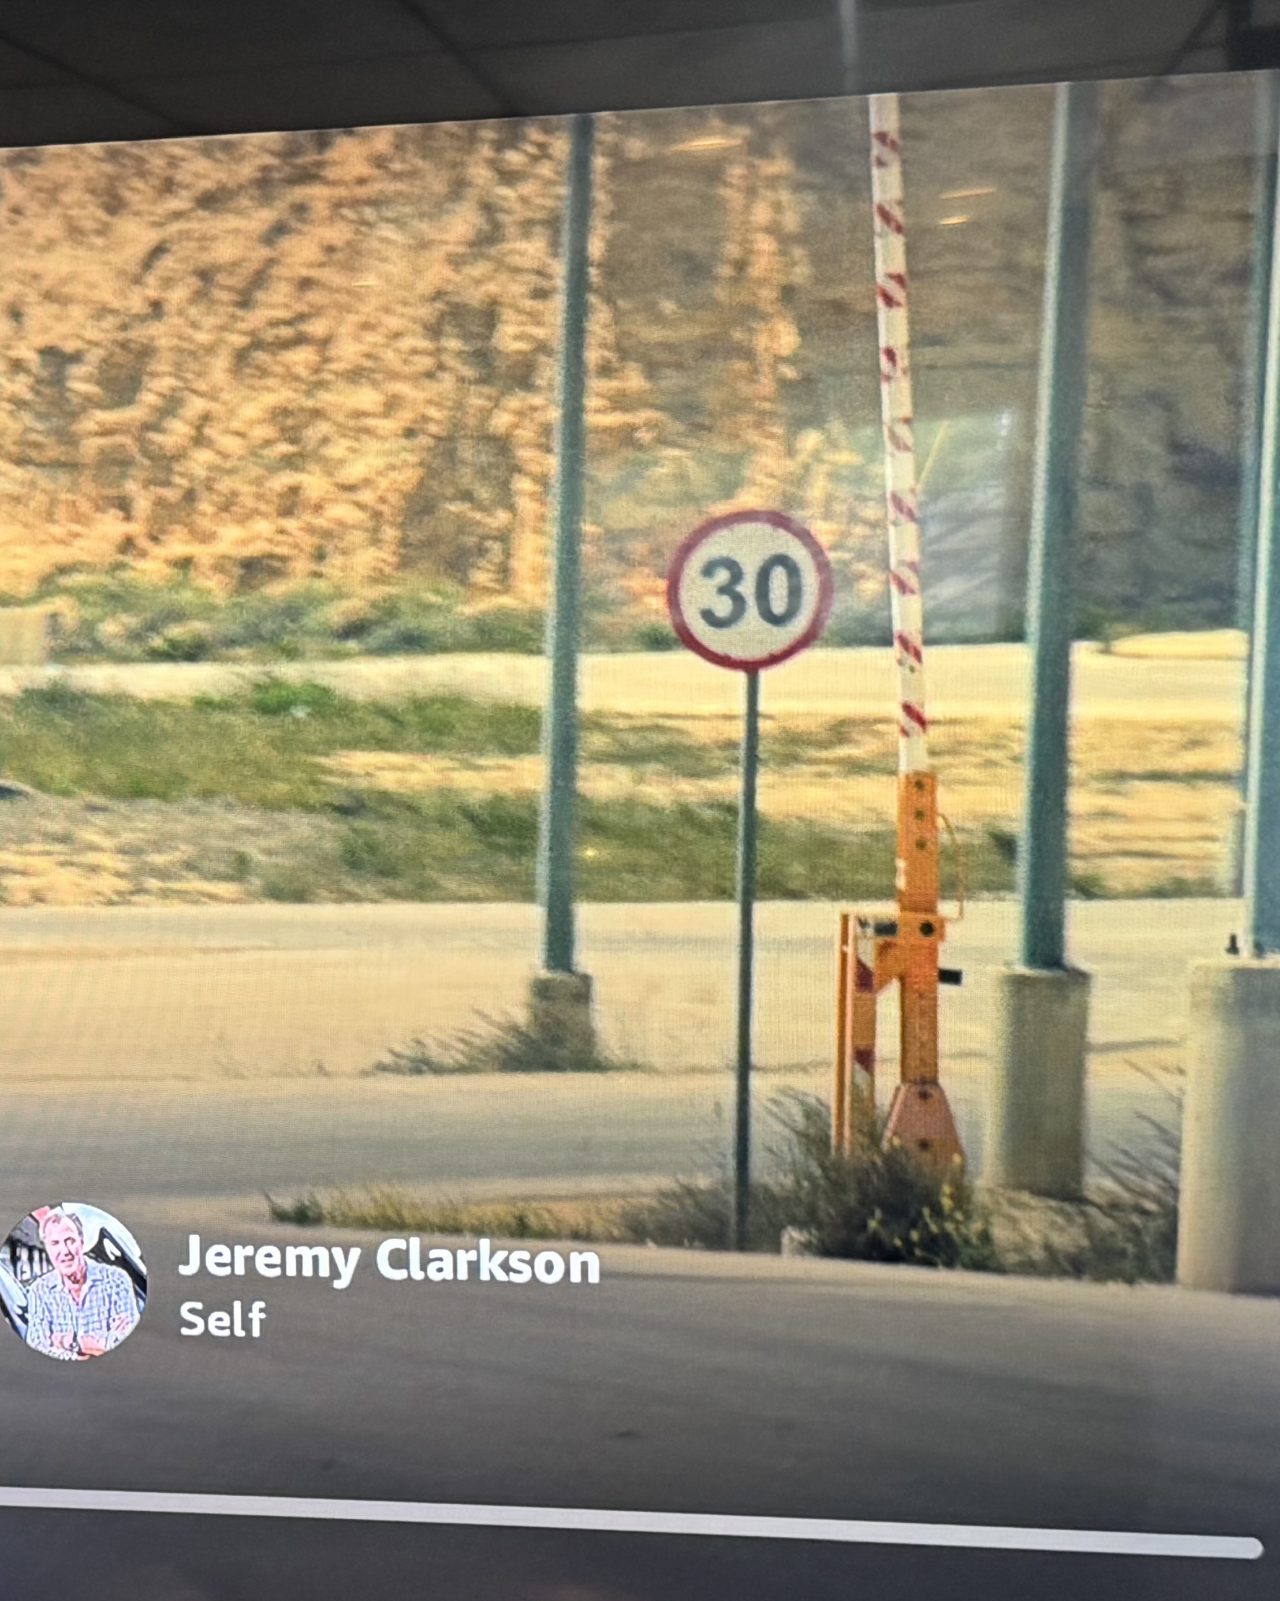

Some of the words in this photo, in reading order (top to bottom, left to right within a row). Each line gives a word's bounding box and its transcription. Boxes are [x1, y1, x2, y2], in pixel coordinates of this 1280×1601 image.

[700, 553, 802, 629] 30
[178, 1234, 362, 1290] Jeremy
[376, 1238, 601, 1284] Clarkson
[180, 1300, 267, 1338] Self
